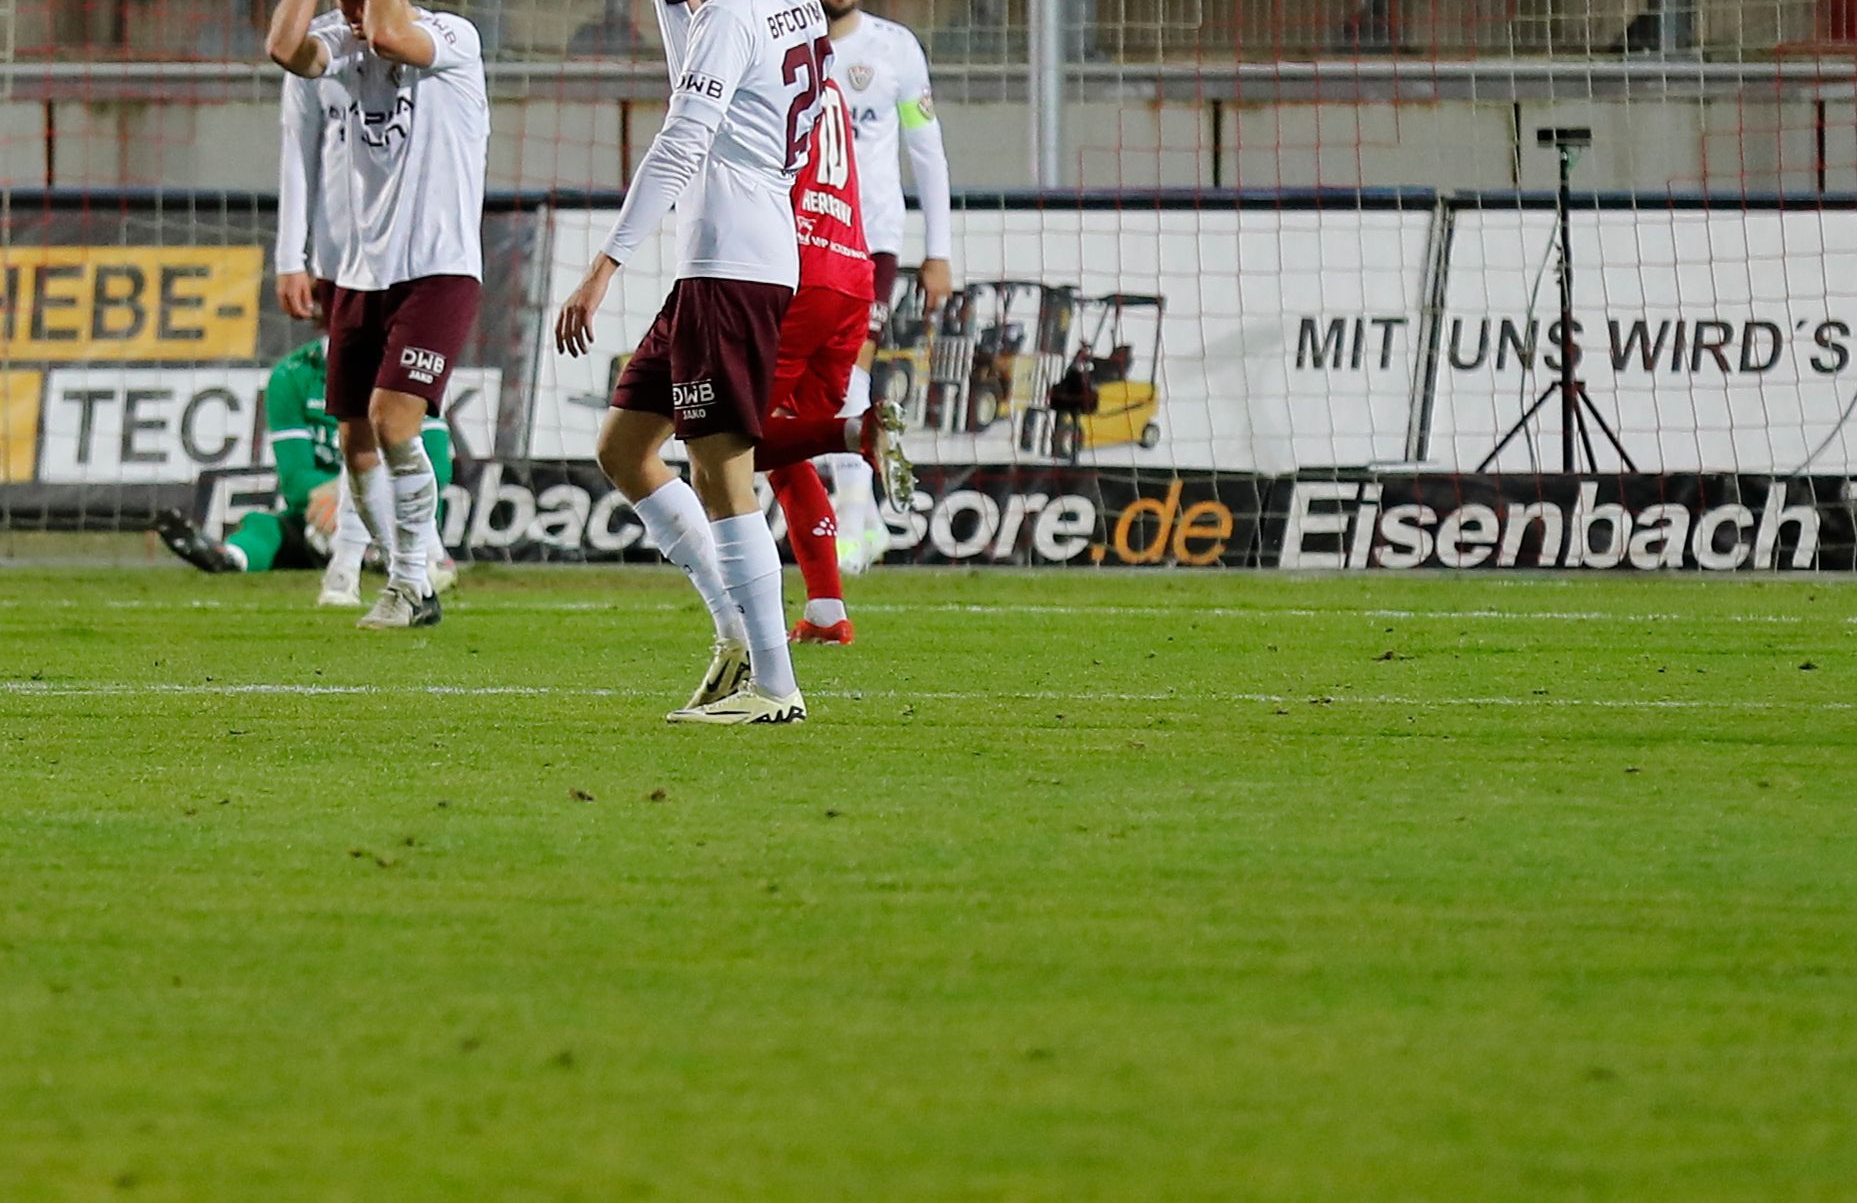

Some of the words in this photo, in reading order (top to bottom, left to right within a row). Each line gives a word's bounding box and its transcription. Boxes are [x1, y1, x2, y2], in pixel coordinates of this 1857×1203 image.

[1295, 317, 1408, 370] MIT
[1448, 317, 1585, 372] UNS
[400, 347, 445, 375] DWB
[408, 369, 434, 384] JAKO
[683, 408, 707, 421] JAKO
[1279, 481, 1821, 570] Eisenbach
